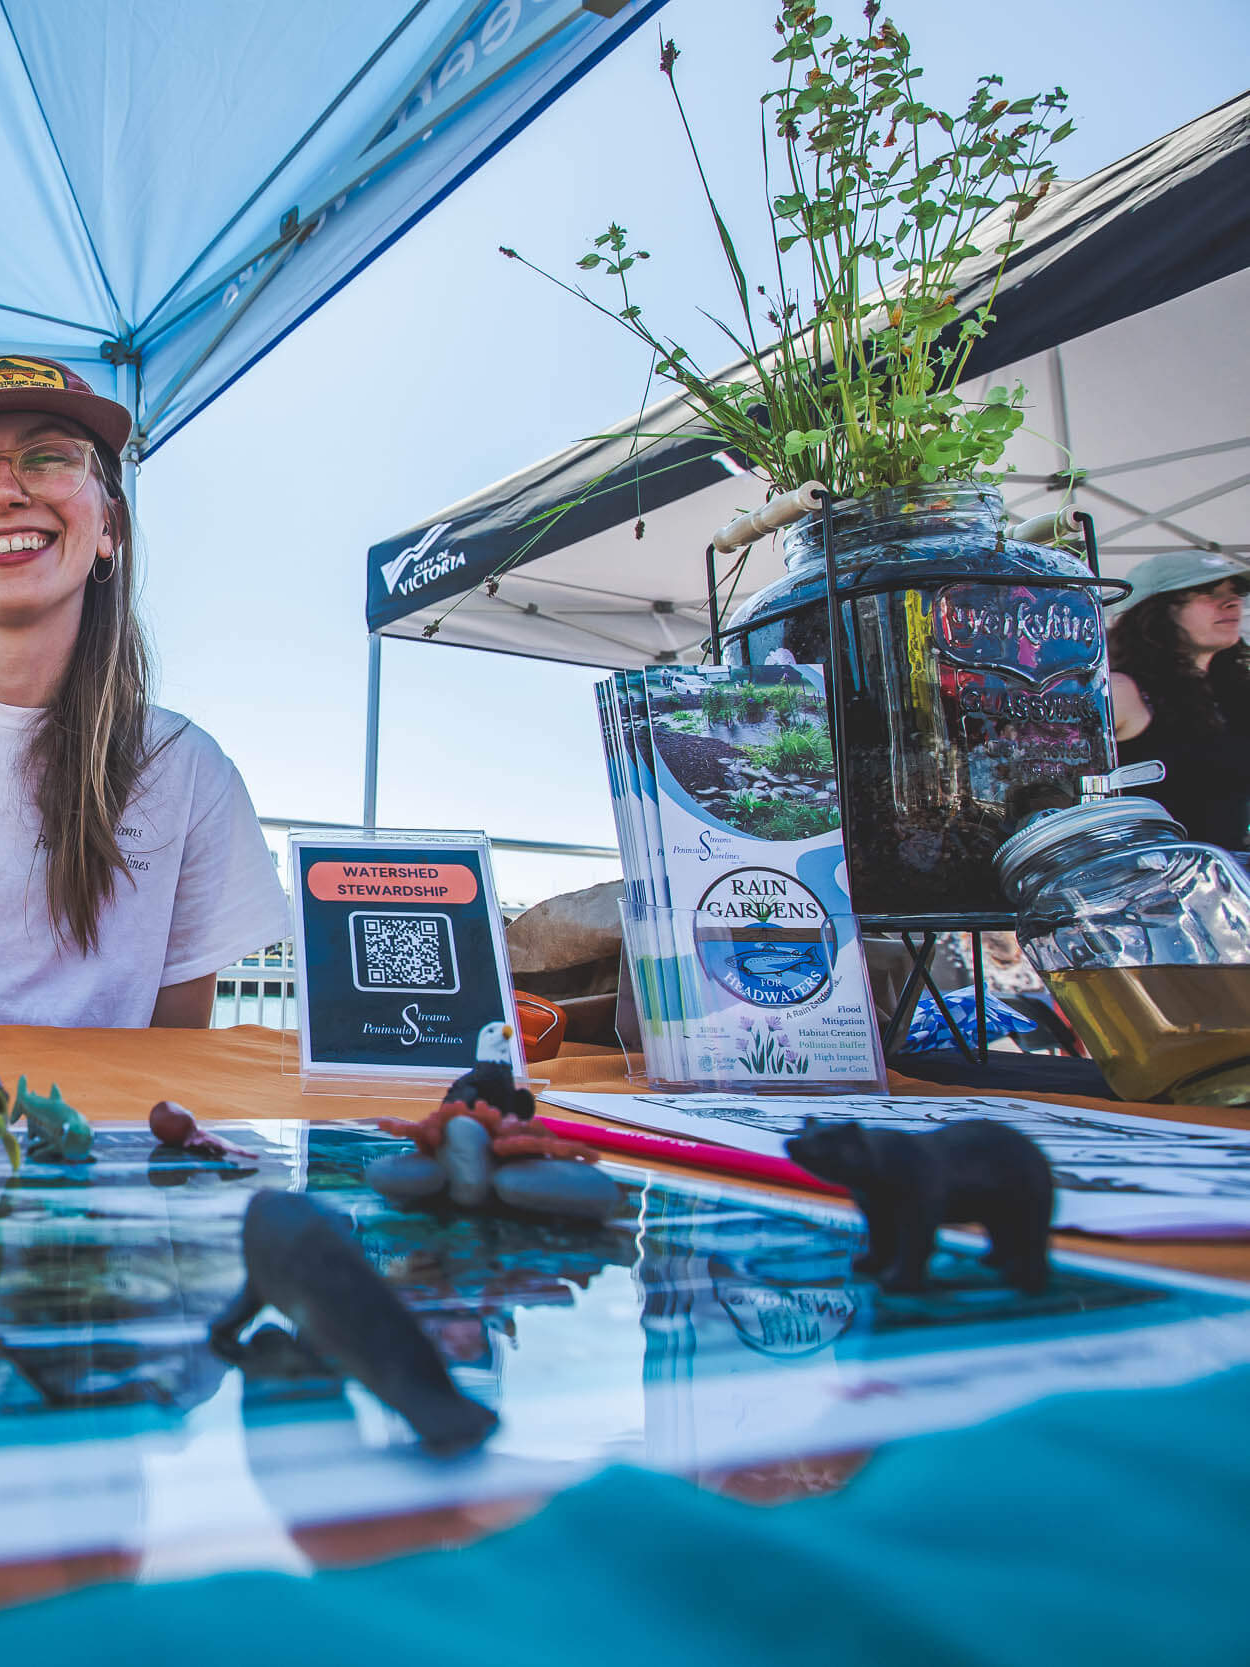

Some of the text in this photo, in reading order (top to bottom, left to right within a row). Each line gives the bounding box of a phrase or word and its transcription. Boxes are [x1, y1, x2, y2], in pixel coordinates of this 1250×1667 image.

[414, 549, 450, 573] CITY OF
[398, 552, 467, 596] VICTORIA
[125, 854, 151, 871] lines
[342, 866, 439, 879] WATERSHED
[337, 884, 449, 897] STEWARDSHIP
[731, 880, 787, 896] RAIN
[706, 902, 819, 919] GARDENS
[724, 970, 823, 1003] HEADWATERS
[760, 978, 783, 988] FOR
[792, 1006, 811, 1018] Rain
[837, 1005, 862, 1013] Flood
[822, 1017, 865, 1026] Mitigation
[362, 1023, 412, 1035] Peninsula
[798, 1029, 867, 1037] Habitat Creation
[799, 1041, 866, 1049] Pollution Buffer
[813, 1053, 835, 1063] High
[829, 1065, 847, 1073] Low
